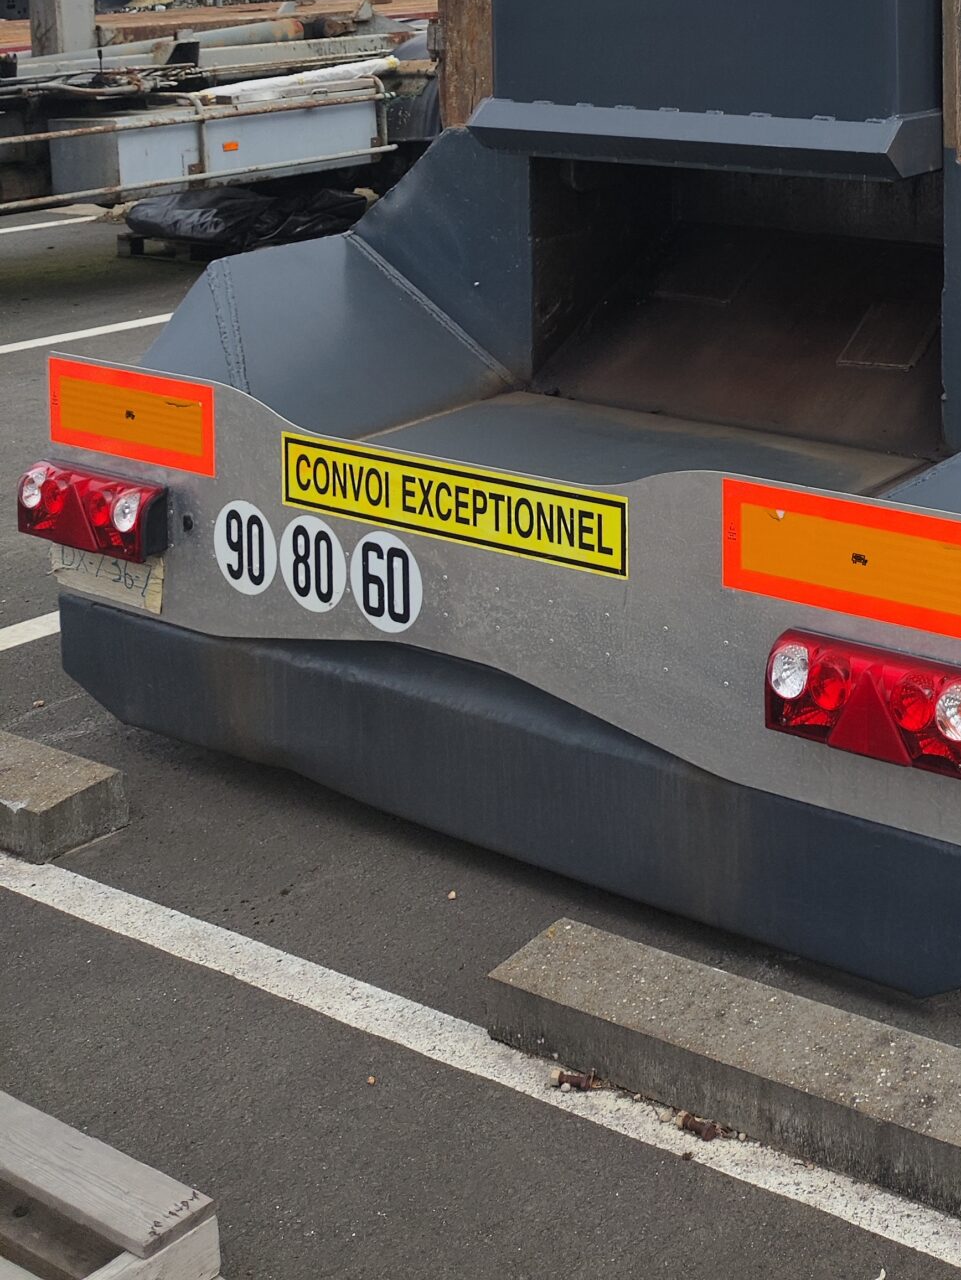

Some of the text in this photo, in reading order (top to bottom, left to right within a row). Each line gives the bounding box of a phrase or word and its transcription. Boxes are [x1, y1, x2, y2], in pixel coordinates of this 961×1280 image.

[295, 453, 614, 556] CONVOI EXCEPTIONNEL
[226, 508, 265, 586] 90
[292, 524, 334, 604] 80
[361, 540, 410, 625] 60
